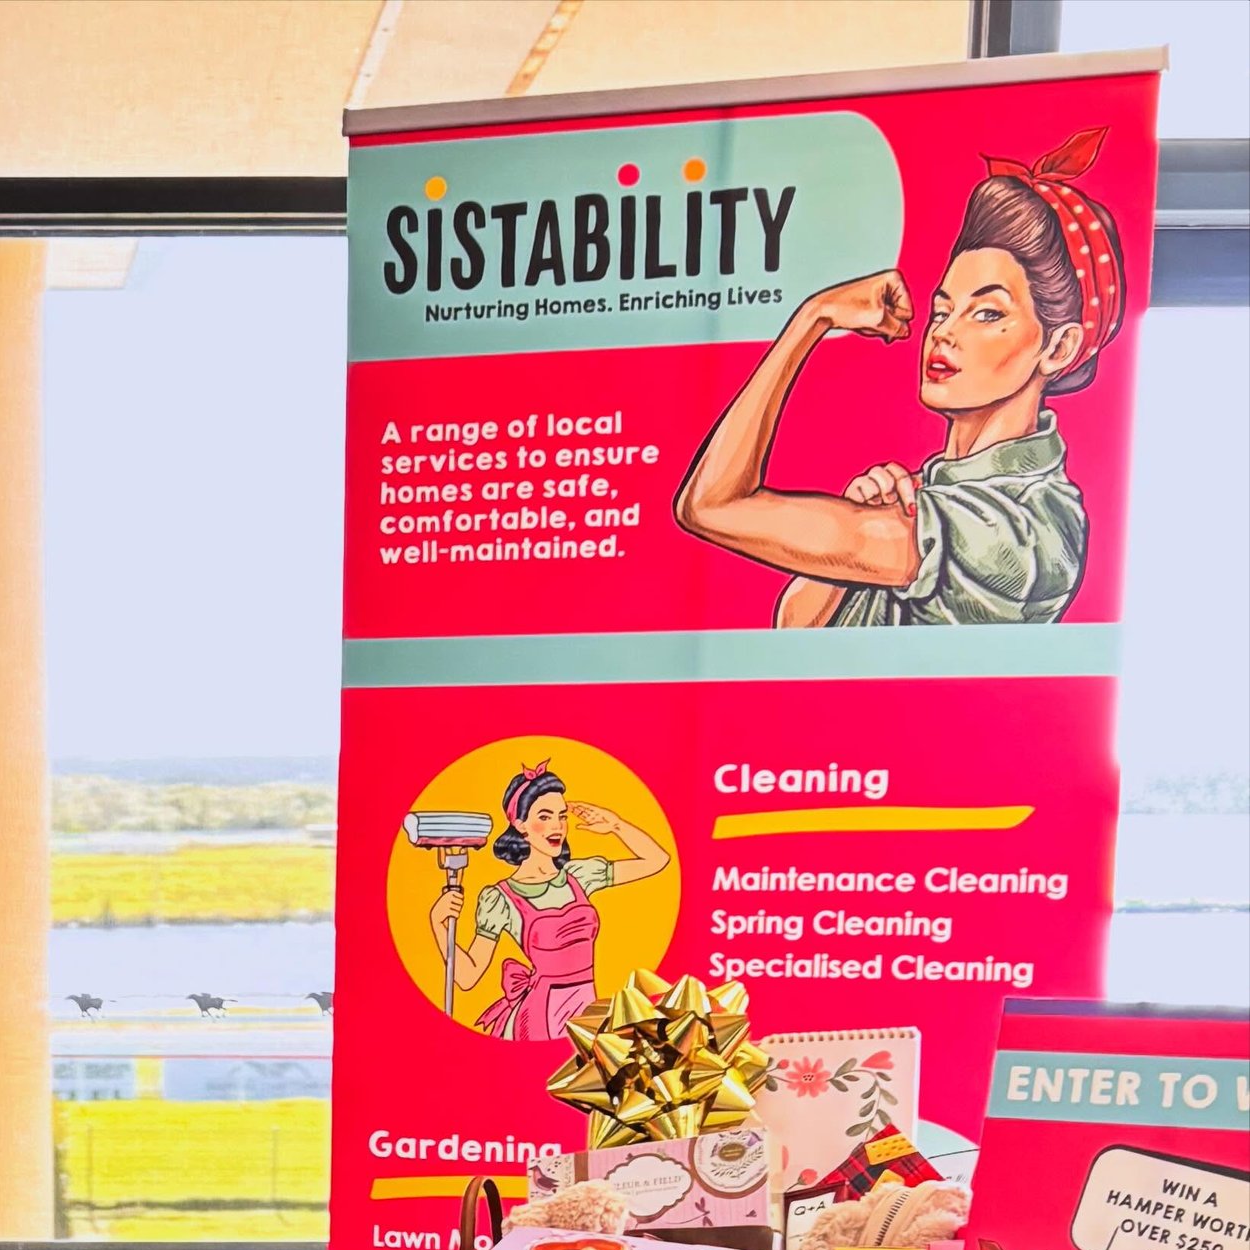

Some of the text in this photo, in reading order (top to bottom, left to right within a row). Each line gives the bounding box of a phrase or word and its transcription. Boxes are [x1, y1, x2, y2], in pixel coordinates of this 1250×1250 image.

[426, 287, 781, 321] Nurturing Homes. Enriching Lives
[382, 411, 621, 445] A range of local
[382, 446, 659, 474] services to ensure
[381, 474, 617, 504] homes are safe,
[380, 503, 639, 534] comfortable, and
[380, 535, 624, 564] well-maintained.
[715, 763, 888, 799] Cleaning
[713, 867, 1067, 899] Maintenance Cleaning
[711, 910, 951, 942] Spring Cleaning
[709, 953, 1034, 988] Specialised Cleaning
[1007, 1066, 1141, 1105] ENTER
[1159, 1073, 1217, 1109] TO
[614, 1182, 640, 1190] LEUR
[1162, 1179, 1217, 1207] WIN A
[1107, 1190, 1185, 1223] HAMPER
[373, 1224, 440, 1250] Lawn
[1120, 1219, 1171, 1244] OVER
